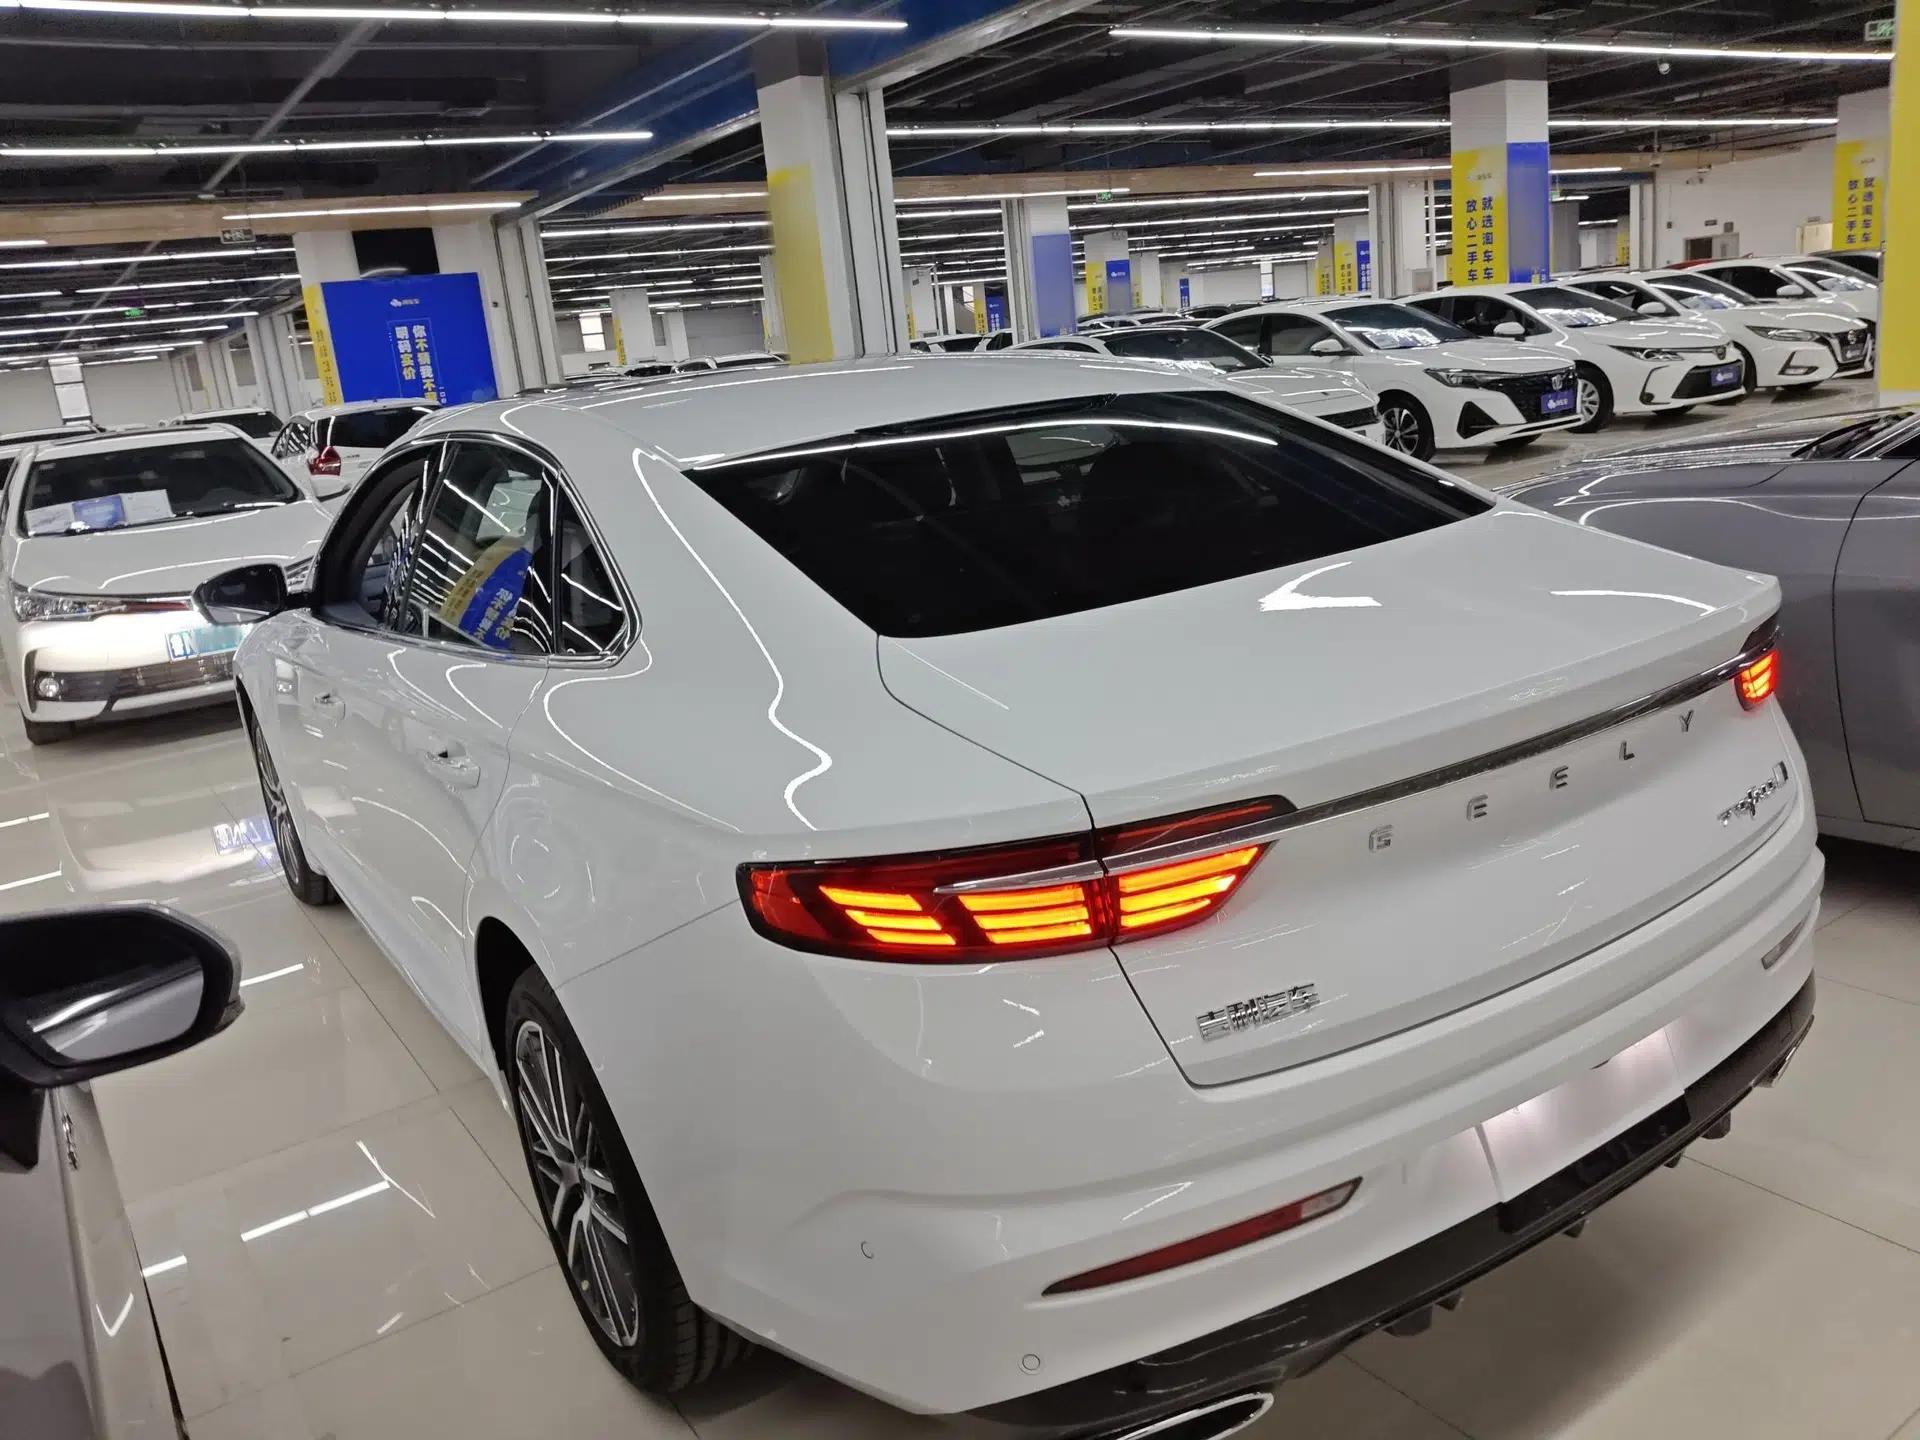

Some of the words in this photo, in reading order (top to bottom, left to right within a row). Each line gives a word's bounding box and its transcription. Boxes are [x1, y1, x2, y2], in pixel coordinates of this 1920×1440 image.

[1466, 199, 1478, 282] 放心二手车
[1481, 195, 1494, 280] 就选淘车车
[1368, 709, 1694, 852] GEELY
